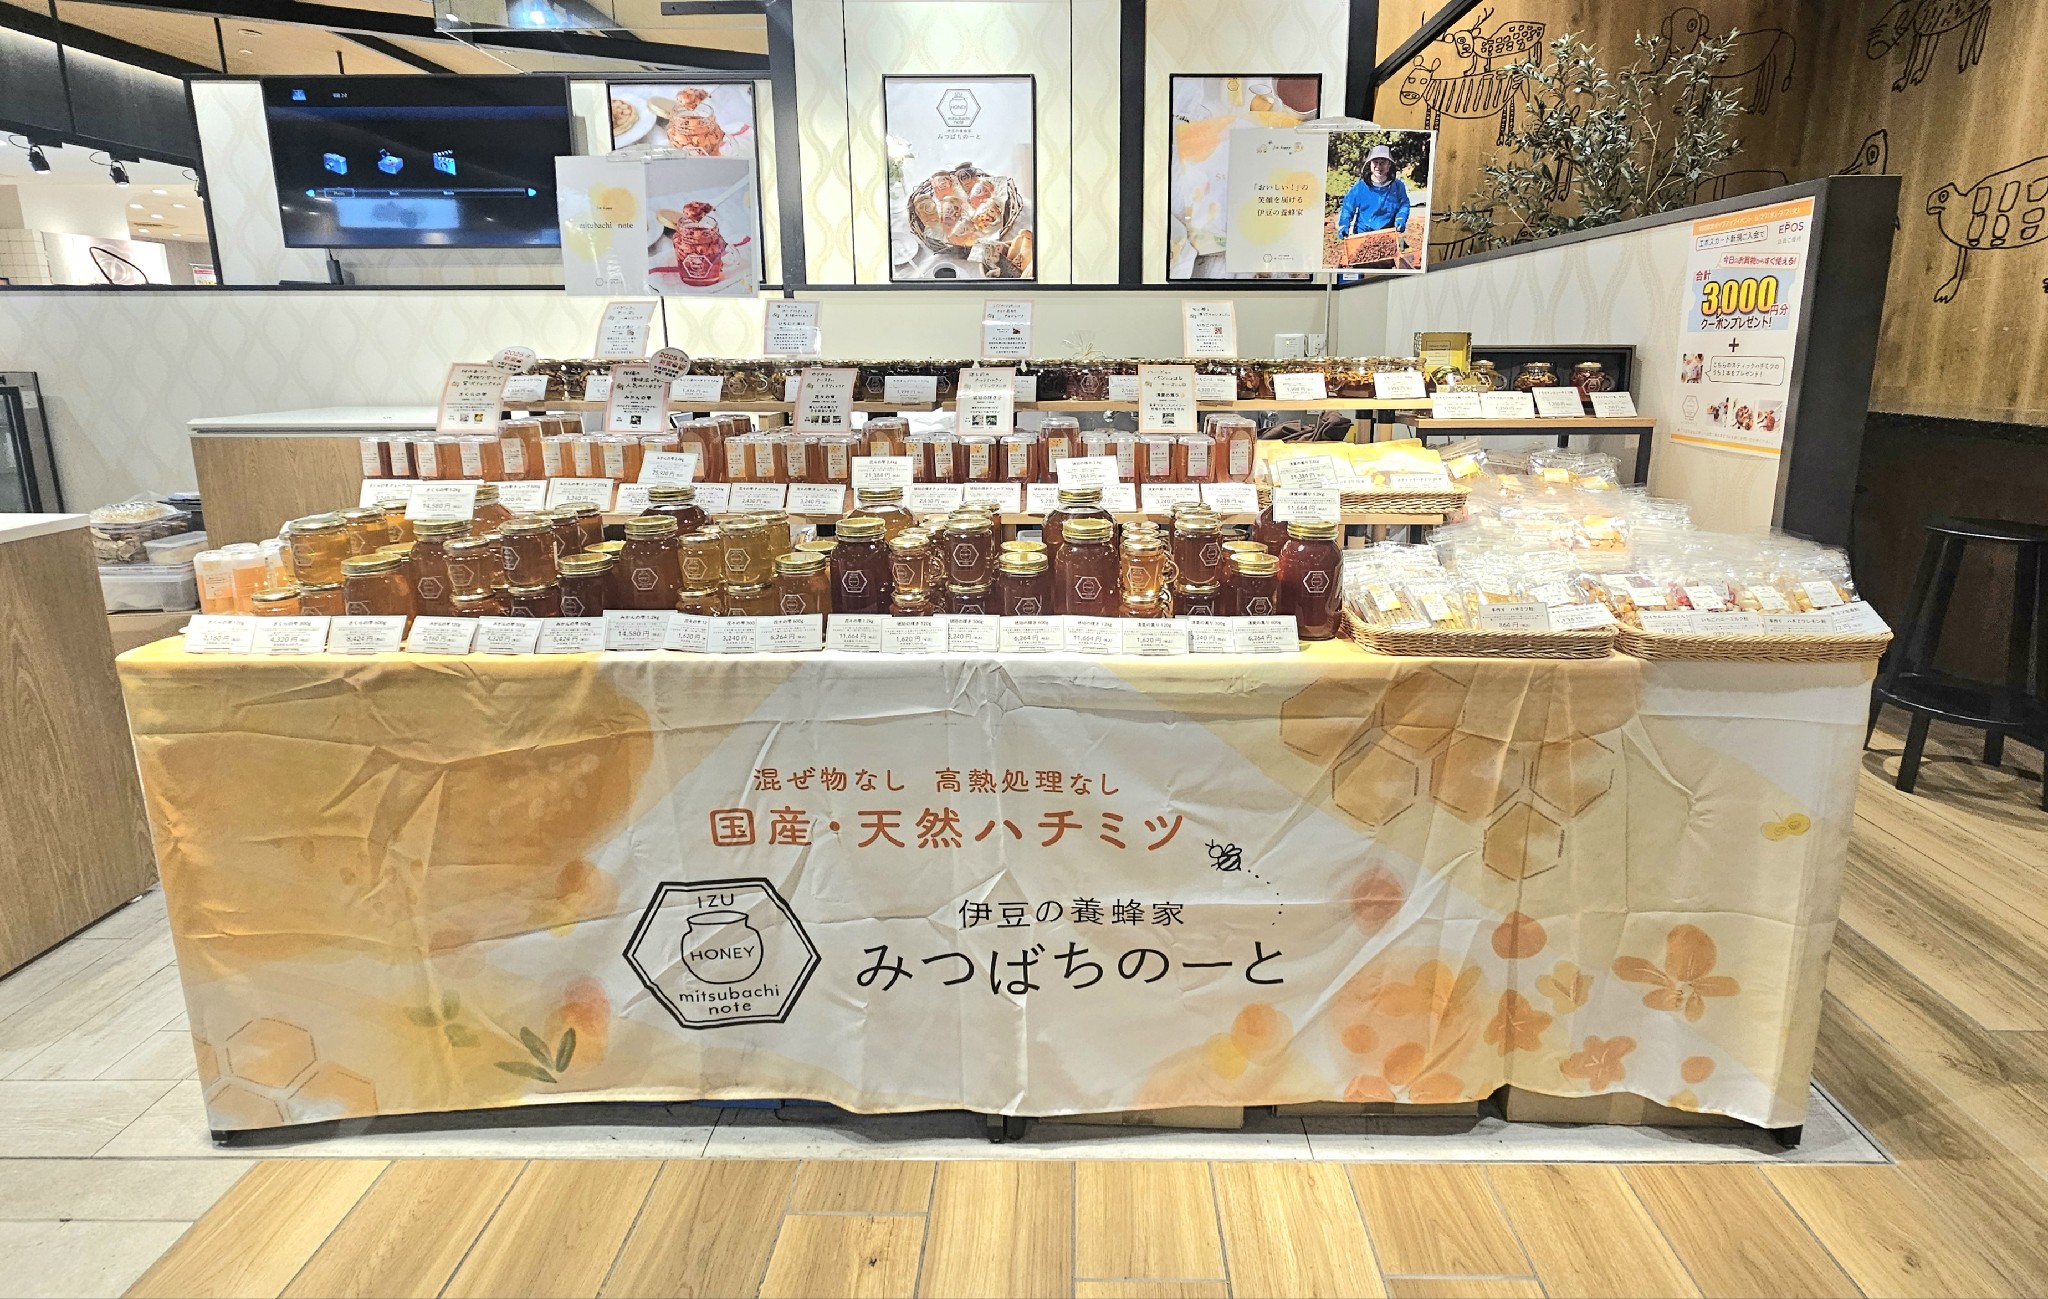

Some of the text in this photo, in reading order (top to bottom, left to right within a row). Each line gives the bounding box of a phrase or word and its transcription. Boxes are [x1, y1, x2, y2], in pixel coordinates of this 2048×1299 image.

[1779, 221, 1804, 234] EPOS
[1695, 270, 1711, 281] 合計
[1770, 304, 1788, 316] 円分
[753, 767, 1121, 796] 混ぜ物なし 高熱処理なし
[709, 807, 1185, 849] 国産・天然ハチミツ
[697, 893, 735, 908] IZU
[958, 897, 1185, 928] 伊豆の養蜂家
[690, 945, 755, 961] HONEY
[856, 941, 1286, 995] みつばちのーと
[679, 984, 780, 1002] mitsubachi
[708, 1001, 752, 1015] note
